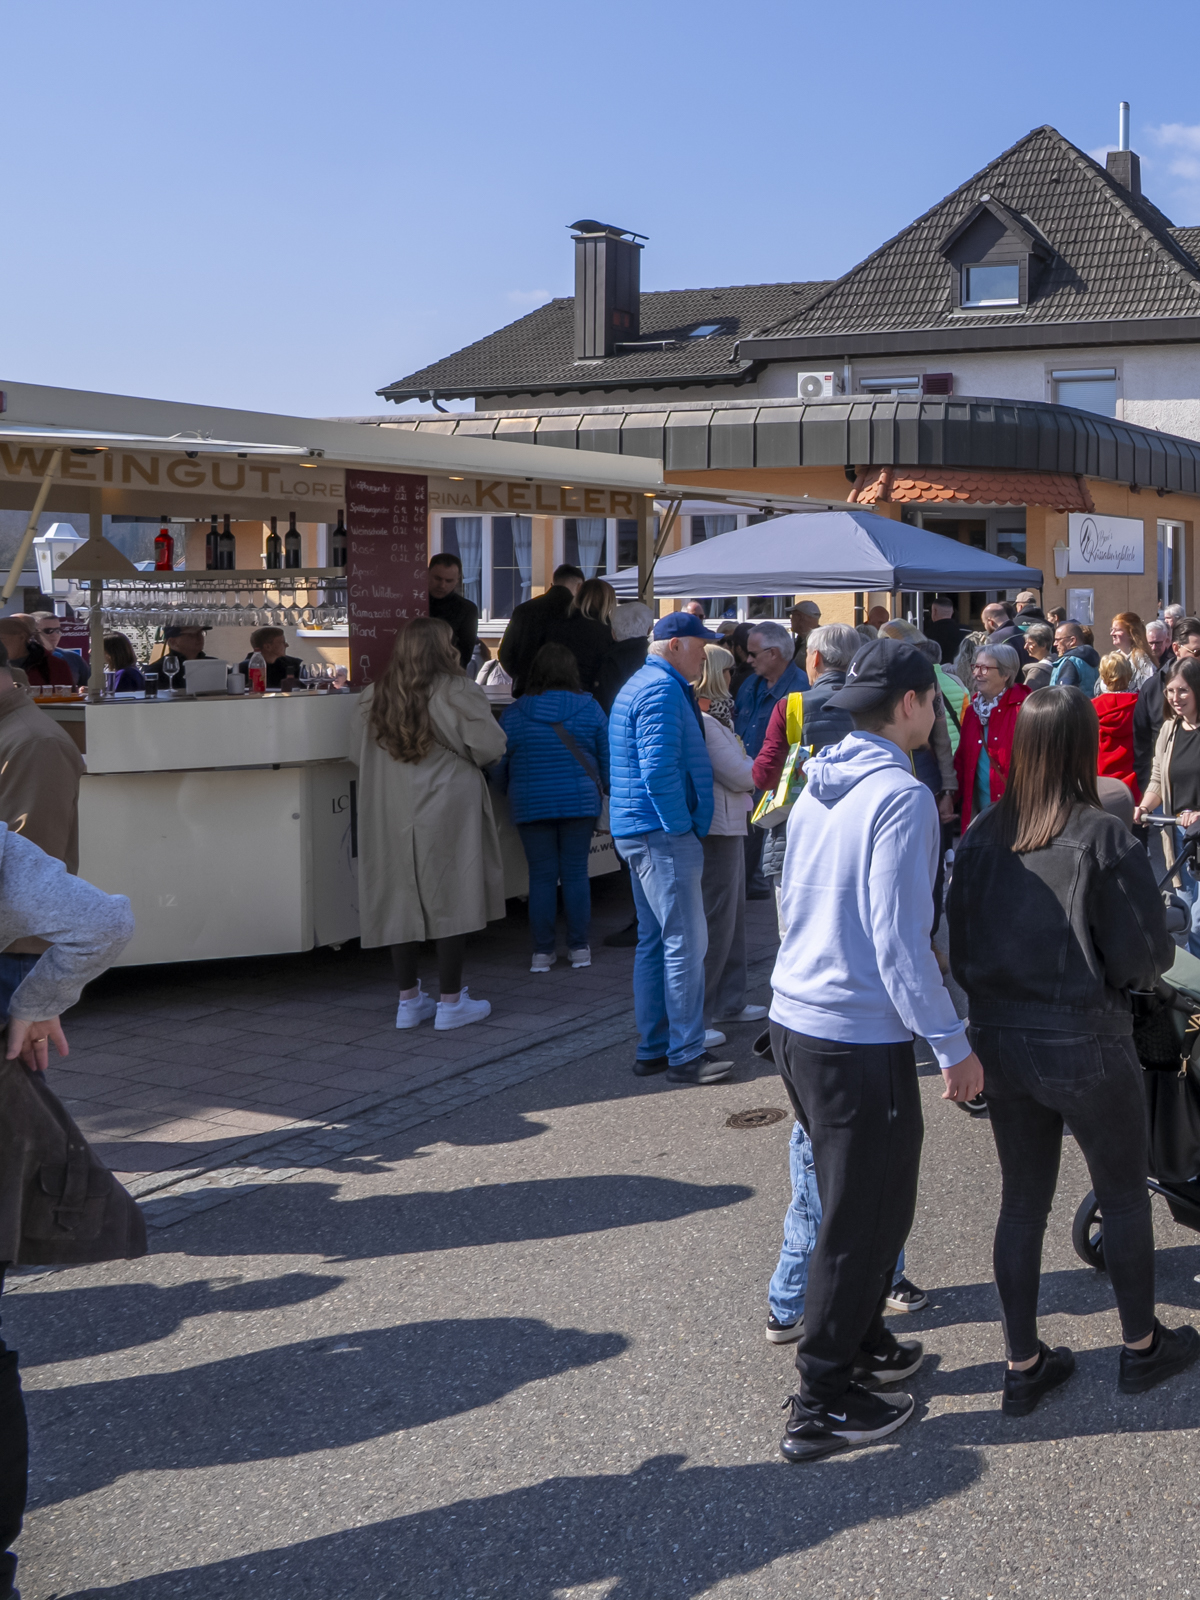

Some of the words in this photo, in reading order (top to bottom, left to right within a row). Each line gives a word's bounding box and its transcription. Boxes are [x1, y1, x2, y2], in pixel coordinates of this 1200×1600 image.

[0, 443, 281, 493] WEINGUT
[280, 480, 344, 498] LORE
[428, 491, 473, 507] RINA
[475, 479, 633, 515] KELLER
[351, 541, 376, 555] Rosé
[414, 552, 426, 562] 6€
[413, 569, 426, 579] 6€
[350, 584, 369, 597] Gin
[413, 589, 426, 601] 7€
[350, 602, 391, 618] Ramazotti
[350, 623, 377, 638] Pfand
